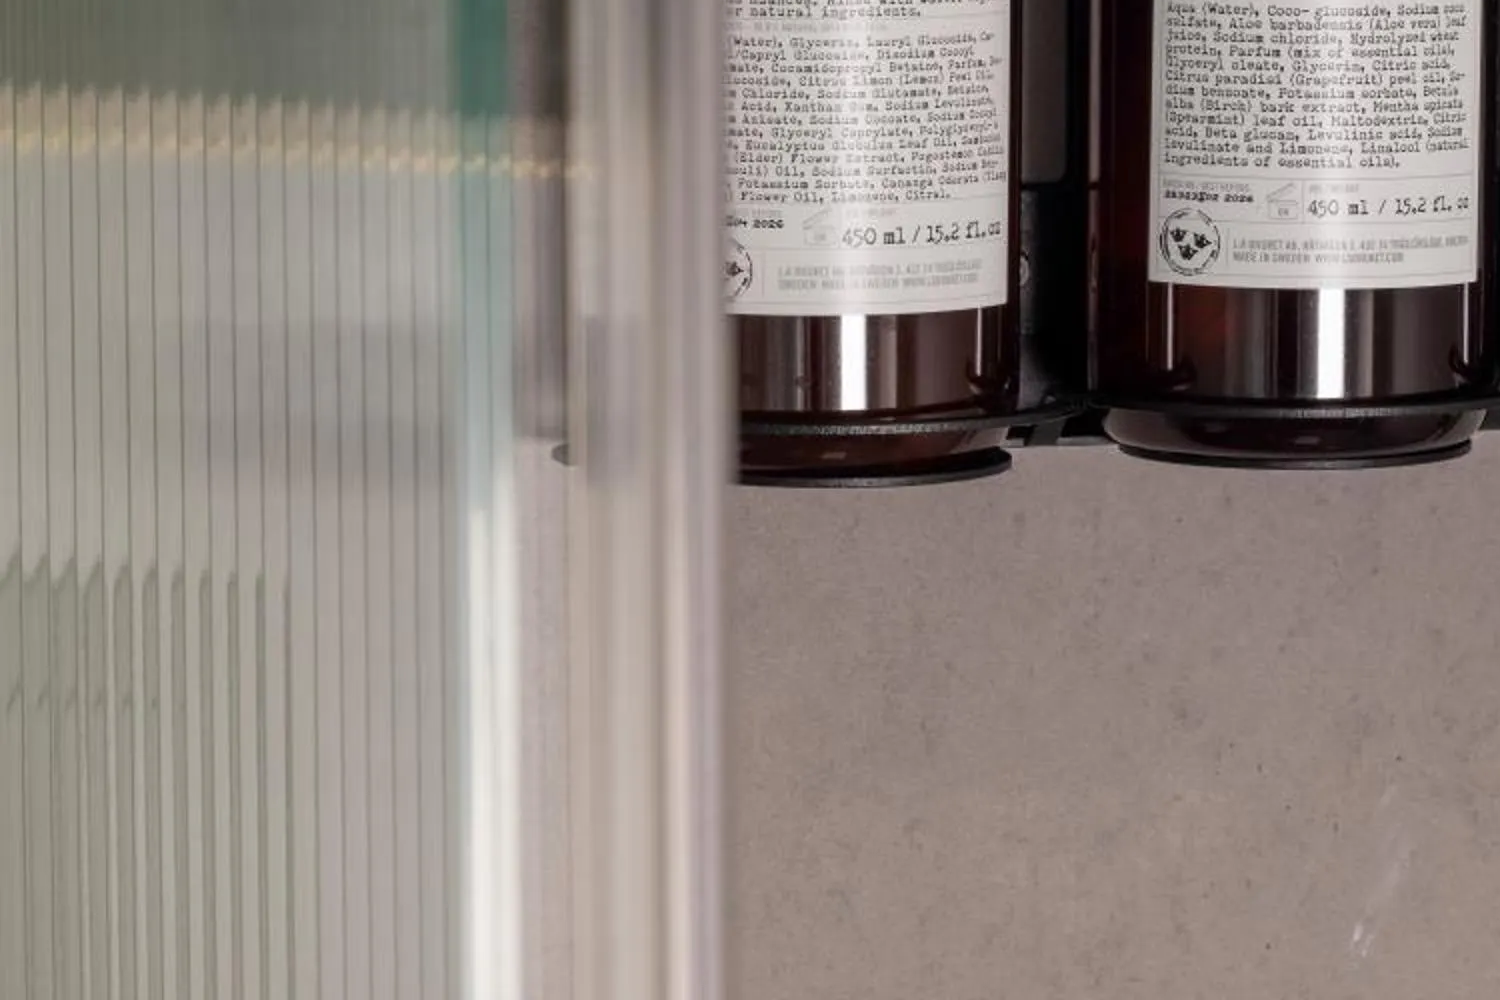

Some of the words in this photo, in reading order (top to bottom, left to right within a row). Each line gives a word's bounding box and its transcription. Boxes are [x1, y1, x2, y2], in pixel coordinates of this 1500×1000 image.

[1308, 200, 1339, 218] 450
[1348, 200, 1369, 215] ml
[1396, 197, 1427, 216] 15.2
[842, 225, 876, 246] 450
[884, 221, 904, 244] ml
[927, 221, 960, 242] 15.2
